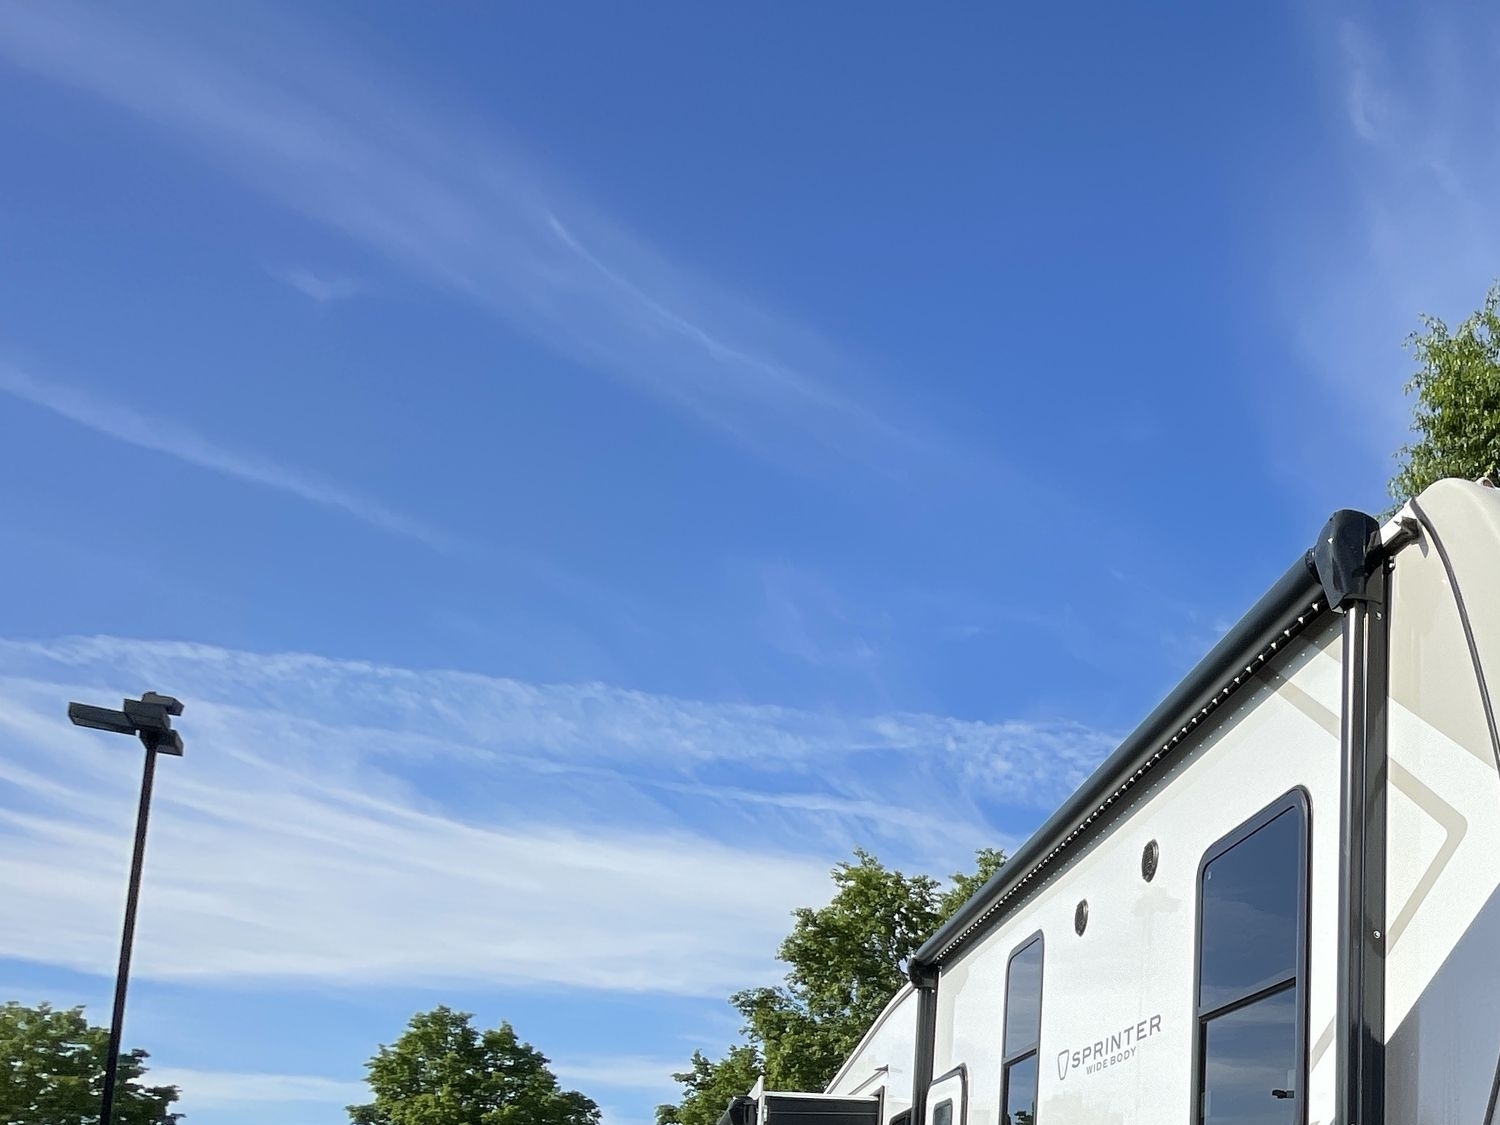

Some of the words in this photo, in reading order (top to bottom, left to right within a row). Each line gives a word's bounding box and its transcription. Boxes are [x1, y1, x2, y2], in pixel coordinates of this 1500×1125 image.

[1071, 1014, 1162, 1069] SPRINTER
[1086, 1058, 1109, 1076] WIDE
[1110, 1046, 1137, 1067] BODY
